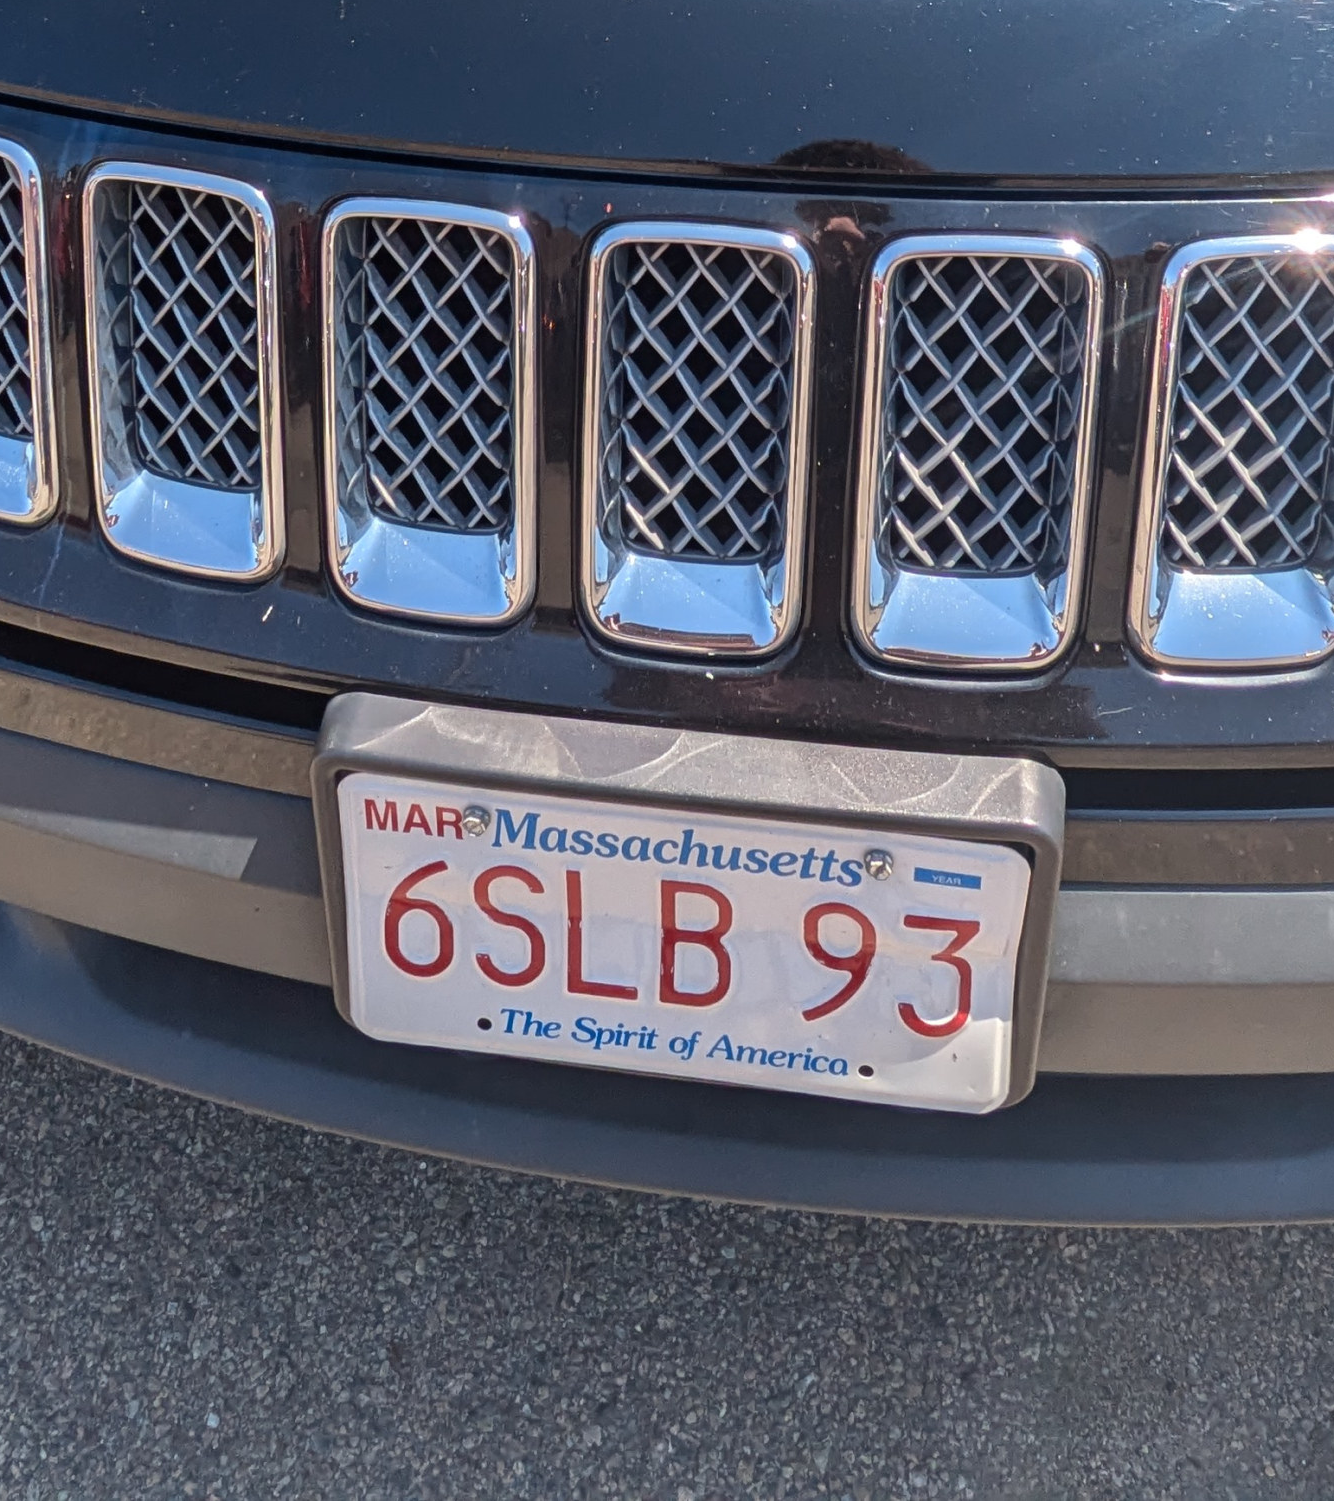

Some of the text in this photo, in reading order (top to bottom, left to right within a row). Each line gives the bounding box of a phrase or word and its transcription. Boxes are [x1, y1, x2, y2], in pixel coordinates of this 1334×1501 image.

[363, 798, 464, 840] MAR
[491, 808, 864, 887] Massachusetts
[931, 874, 962, 886] YEAR
[383, 860, 982, 1039] 6SLB 93
[500, 1008, 849, 1077] The Spirit of America
